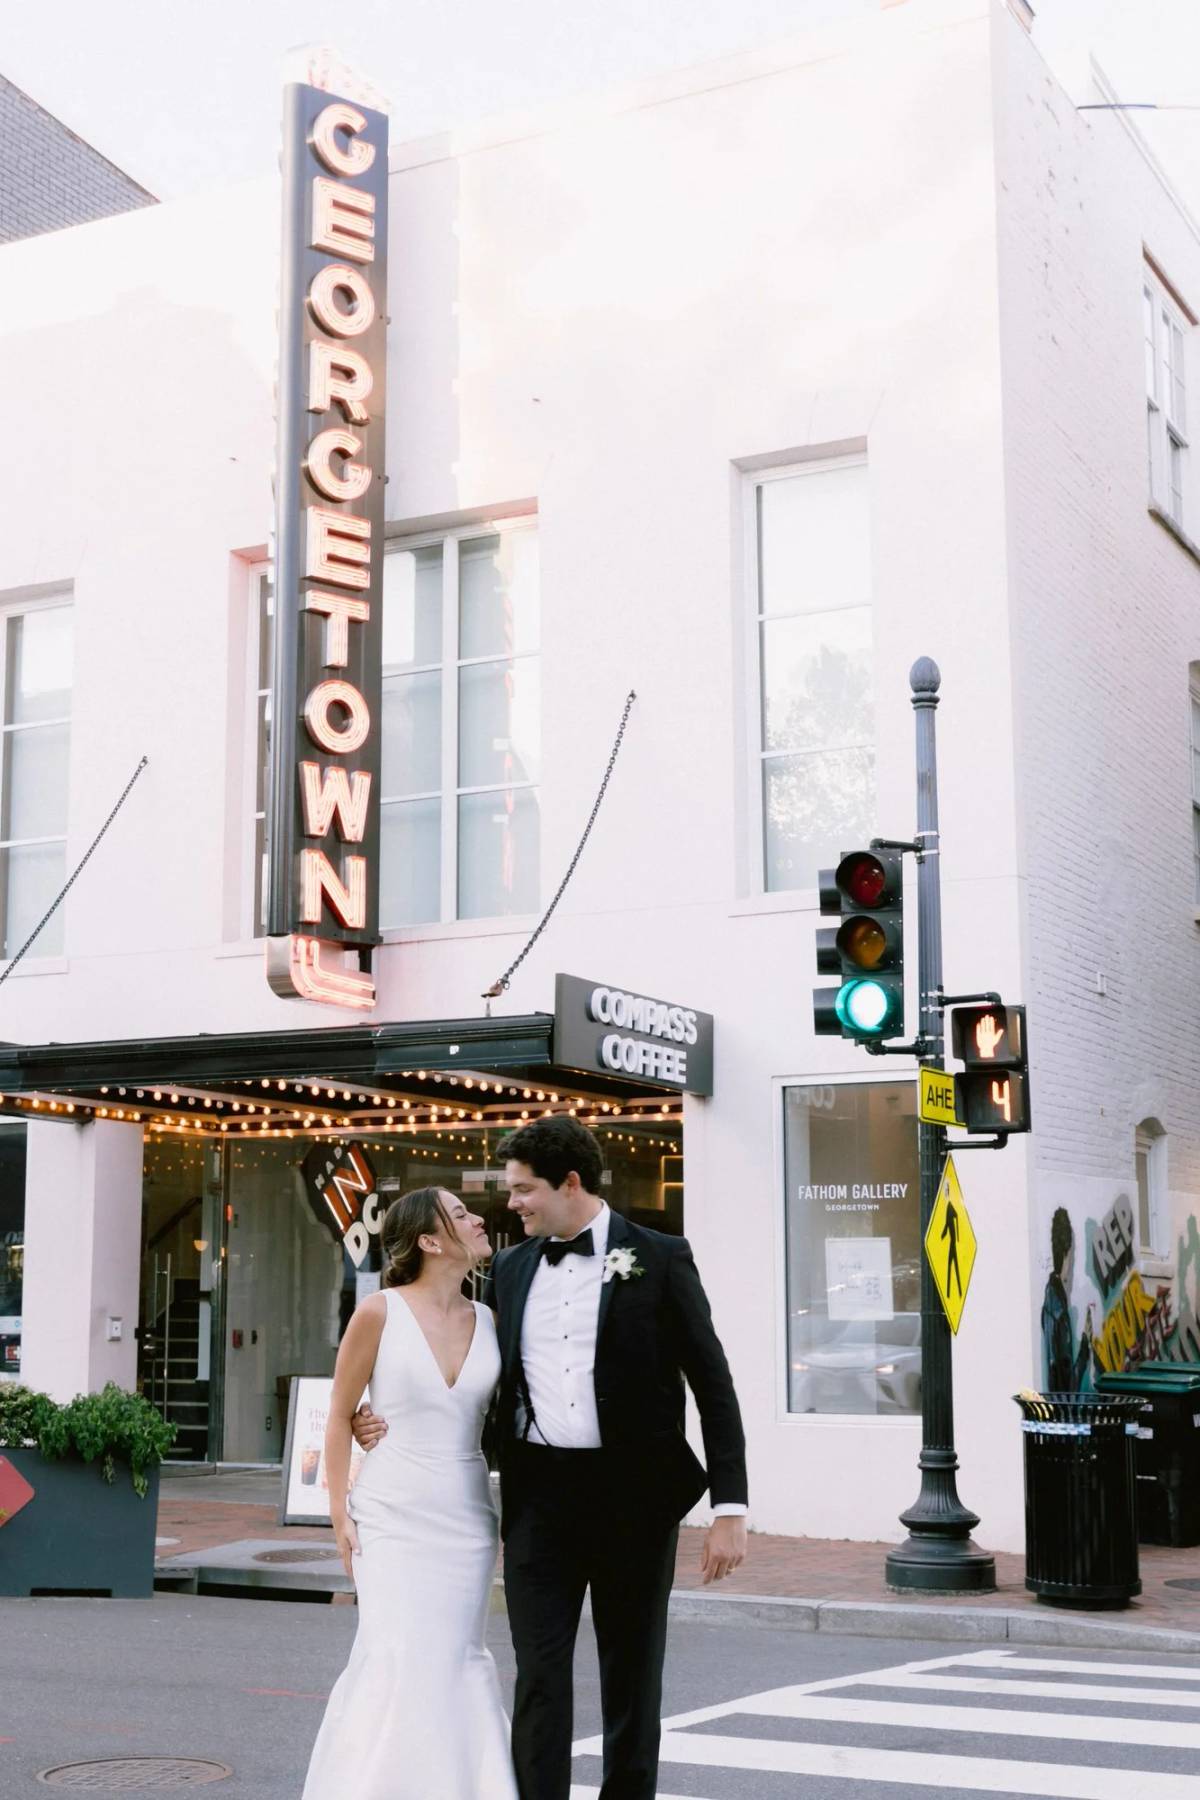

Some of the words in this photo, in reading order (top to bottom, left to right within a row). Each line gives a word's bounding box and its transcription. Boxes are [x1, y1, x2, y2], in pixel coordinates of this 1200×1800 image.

[302, 103, 376, 929] GEORGETOWN
[590, 987, 698, 1045] COMPASS
[601, 1034, 687, 1084] COFFEE
[926, 1085, 955, 1110] AHE
[992, 1079, 1011, 1122] 4
[798, 1184, 847, 1200] FATHOM
[852, 1183, 908, 1199] GALLERY
[825, 1203, 880, 1212] GEORGETOWN
